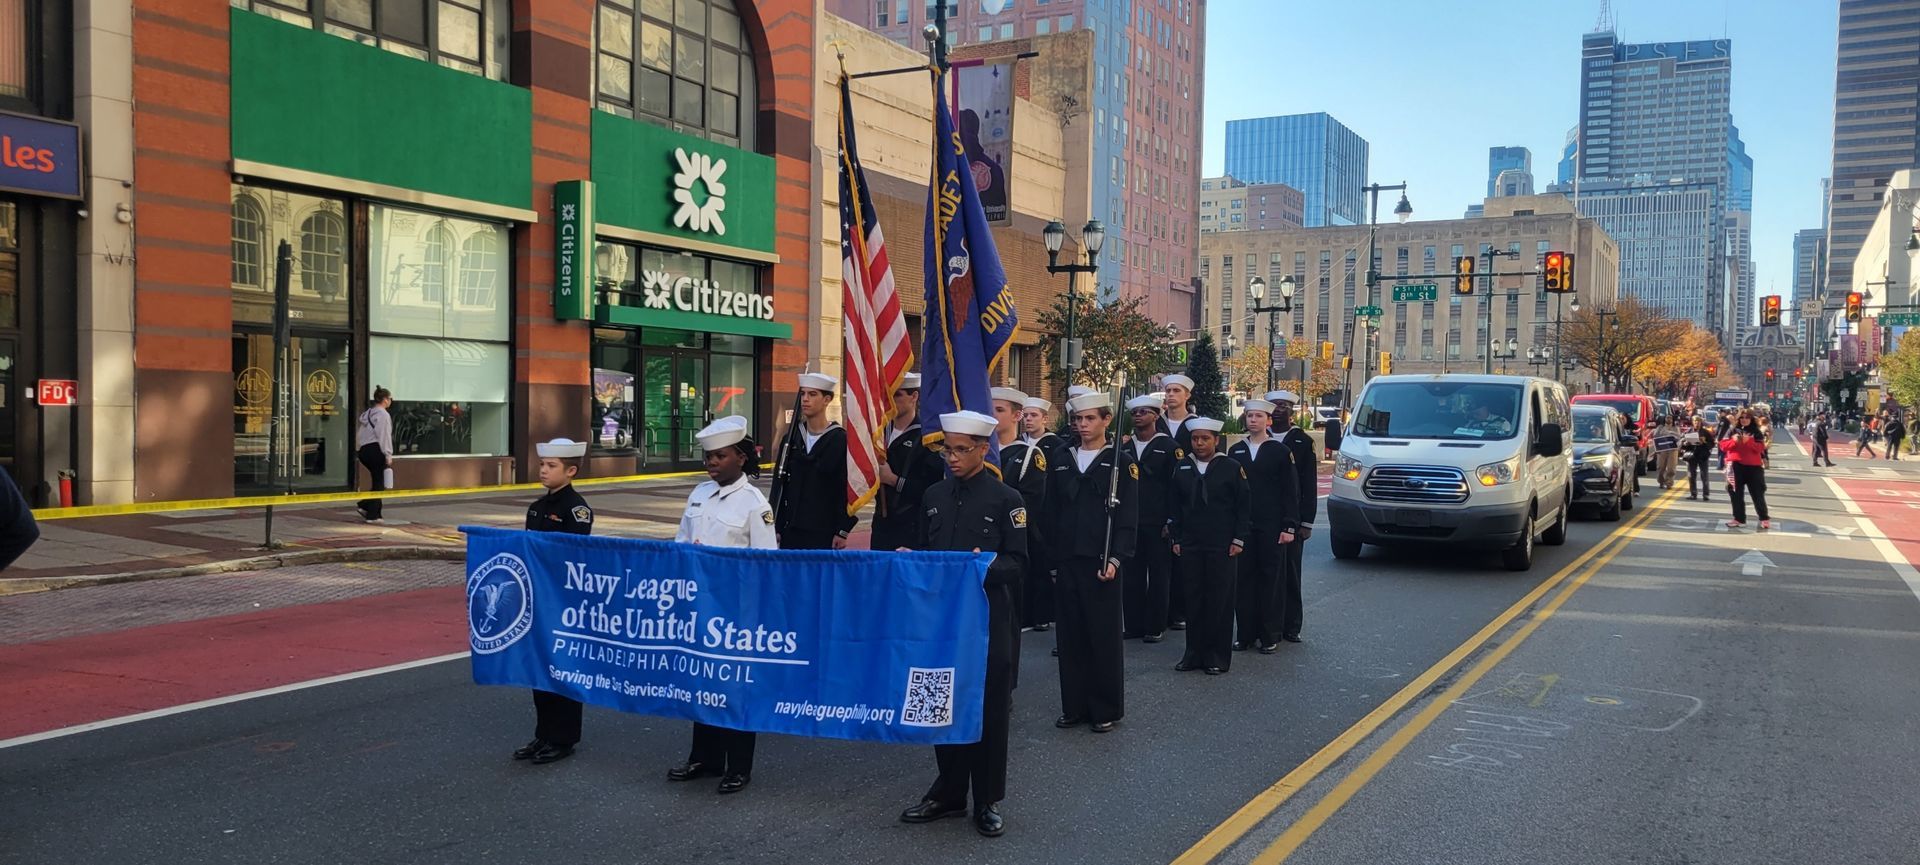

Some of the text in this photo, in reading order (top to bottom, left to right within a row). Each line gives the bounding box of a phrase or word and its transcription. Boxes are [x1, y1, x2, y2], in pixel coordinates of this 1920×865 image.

[561, 223, 574, 296] Citizens
[673, 276, 775, 320] Citizens
[1418, 291, 1429, 300] St
[564, 561, 698, 610] Navy League
[503, 612, 531, 641] STATES
[562, 599, 797, 654] of the United States
[549, 665, 593, 690] Serving
[595, 673, 611, 689] the
[695, 690, 727, 708] 1902
[774, 700, 895, 725] navyleaguephilly.org
